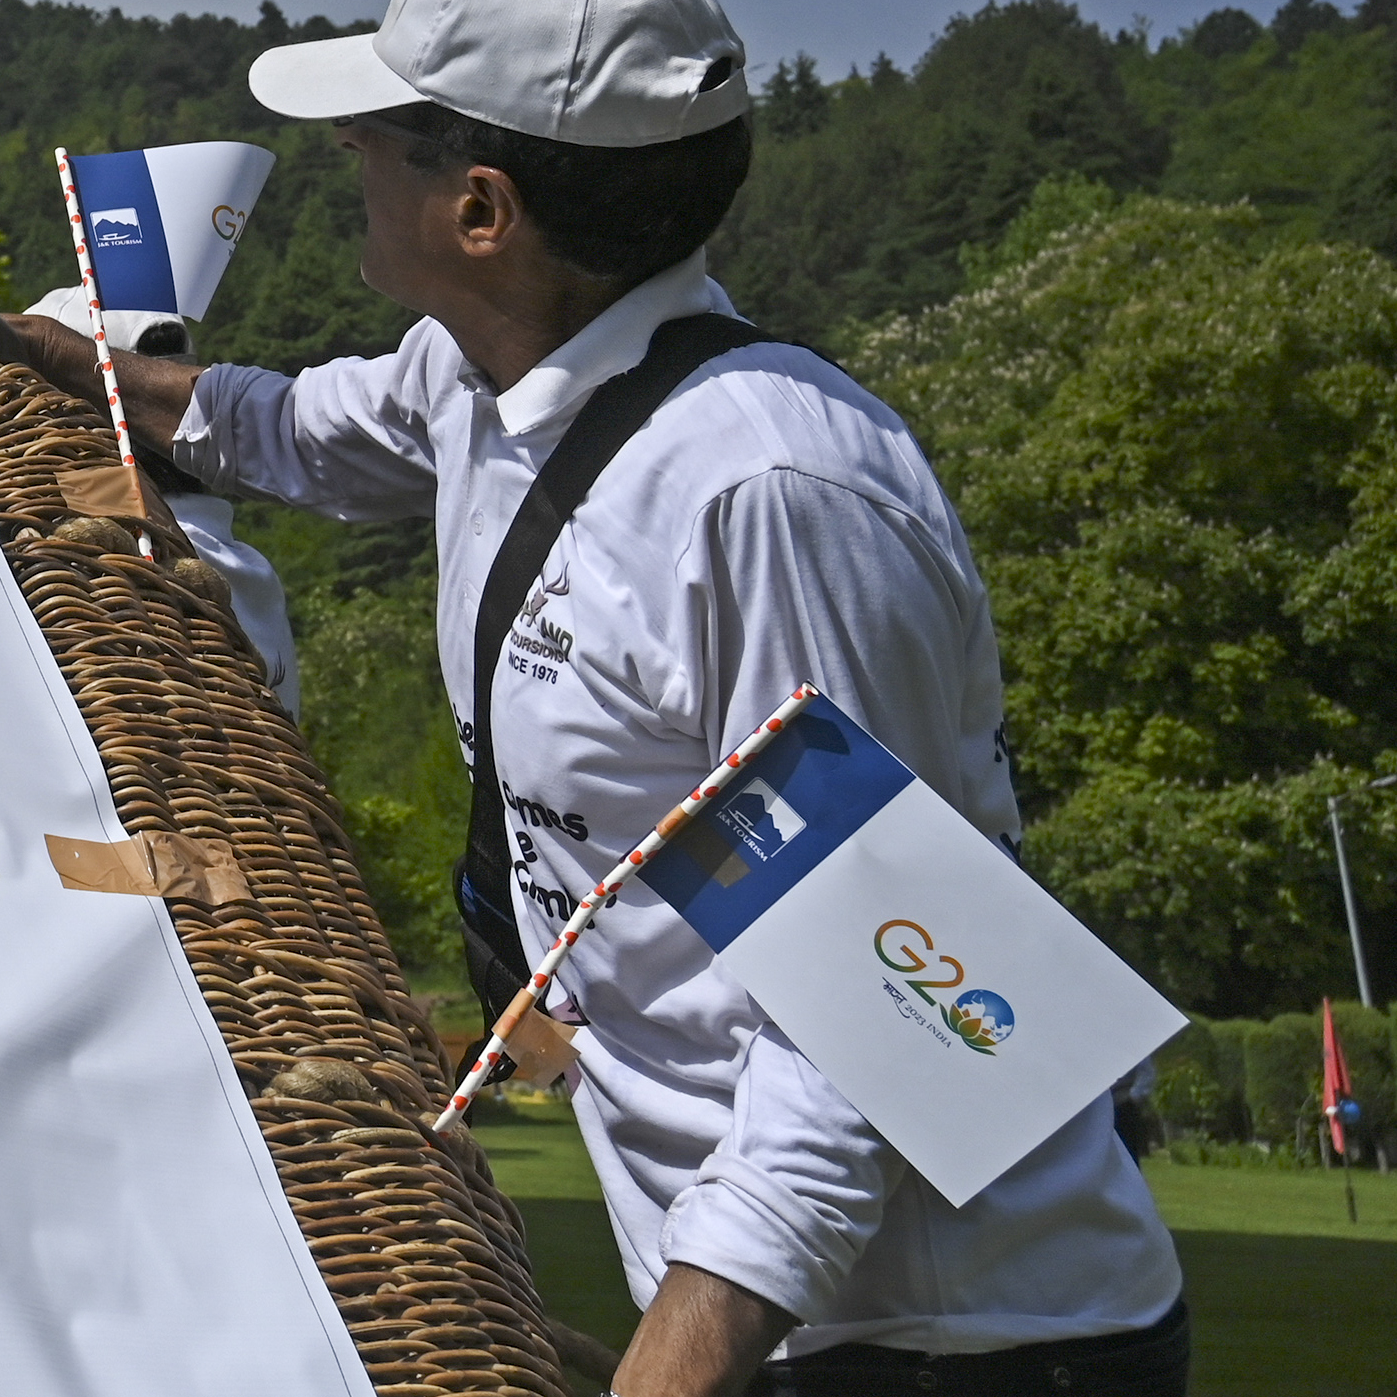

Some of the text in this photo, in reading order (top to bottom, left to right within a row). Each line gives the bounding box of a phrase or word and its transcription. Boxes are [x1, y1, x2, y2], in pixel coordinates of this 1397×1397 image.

[531, 663, 559, 684] 1978
[716, 811, 768, 862] J&K TOURISM
[904, 1004, 952, 1048] 2023 INDIA
